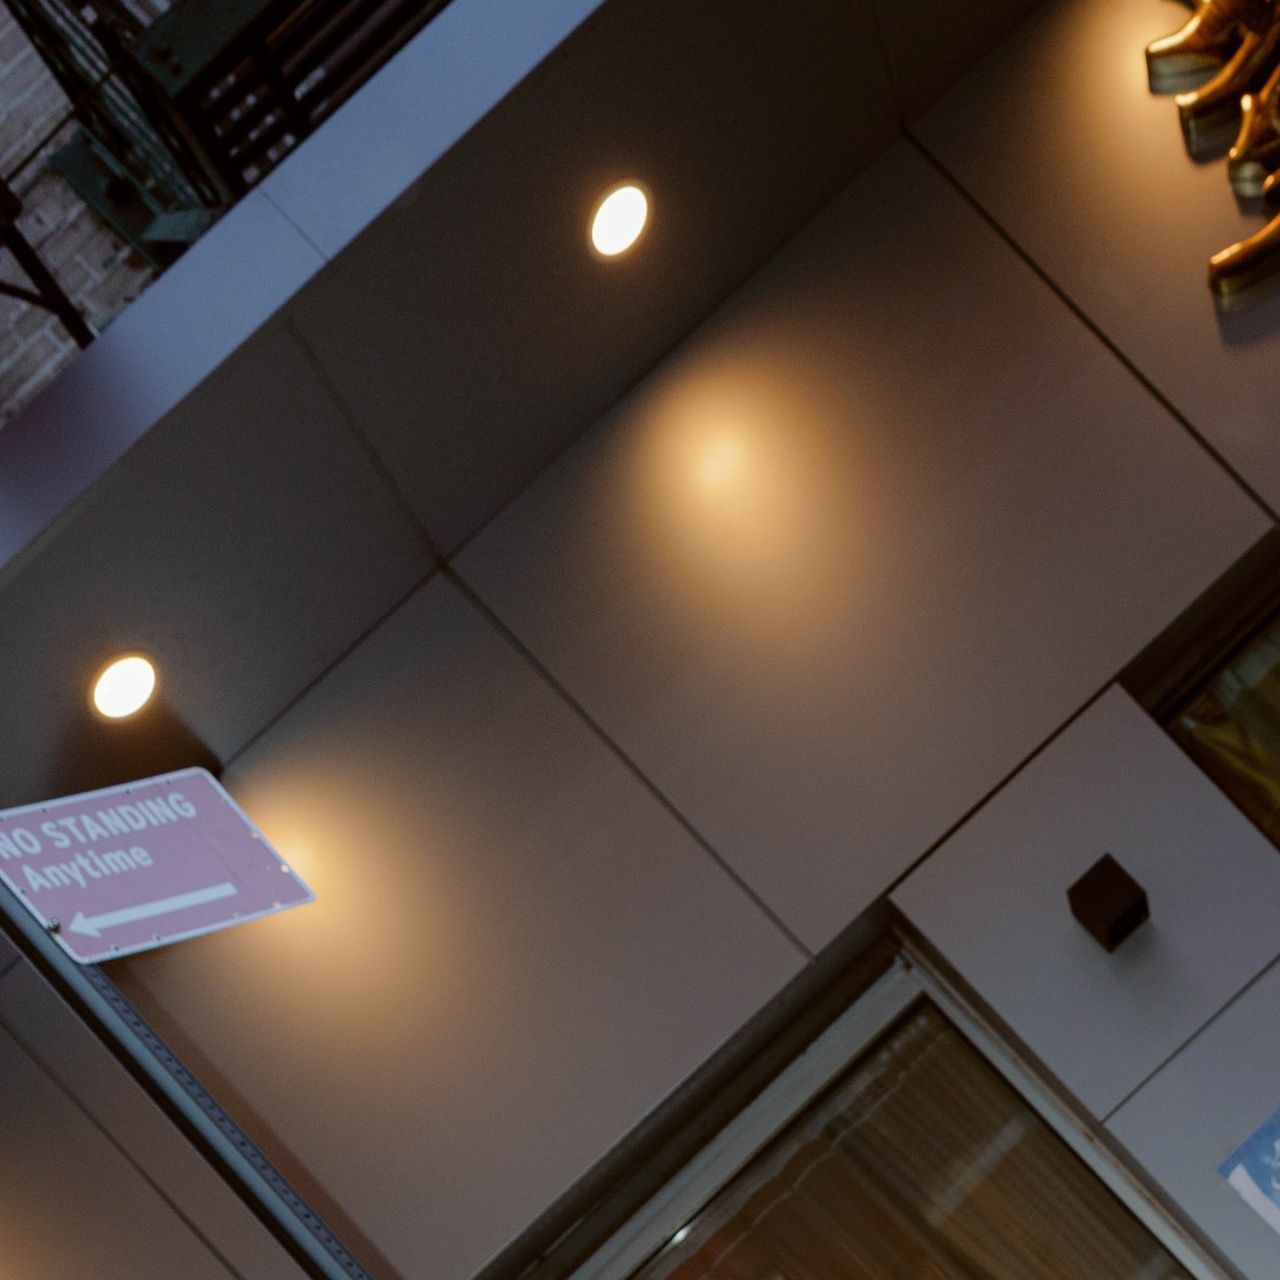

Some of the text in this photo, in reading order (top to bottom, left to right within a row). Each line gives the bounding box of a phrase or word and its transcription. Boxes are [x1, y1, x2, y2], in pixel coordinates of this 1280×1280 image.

[0, 792, 196, 861] NO STANDING
[23, 843, 152, 892] Anytime
